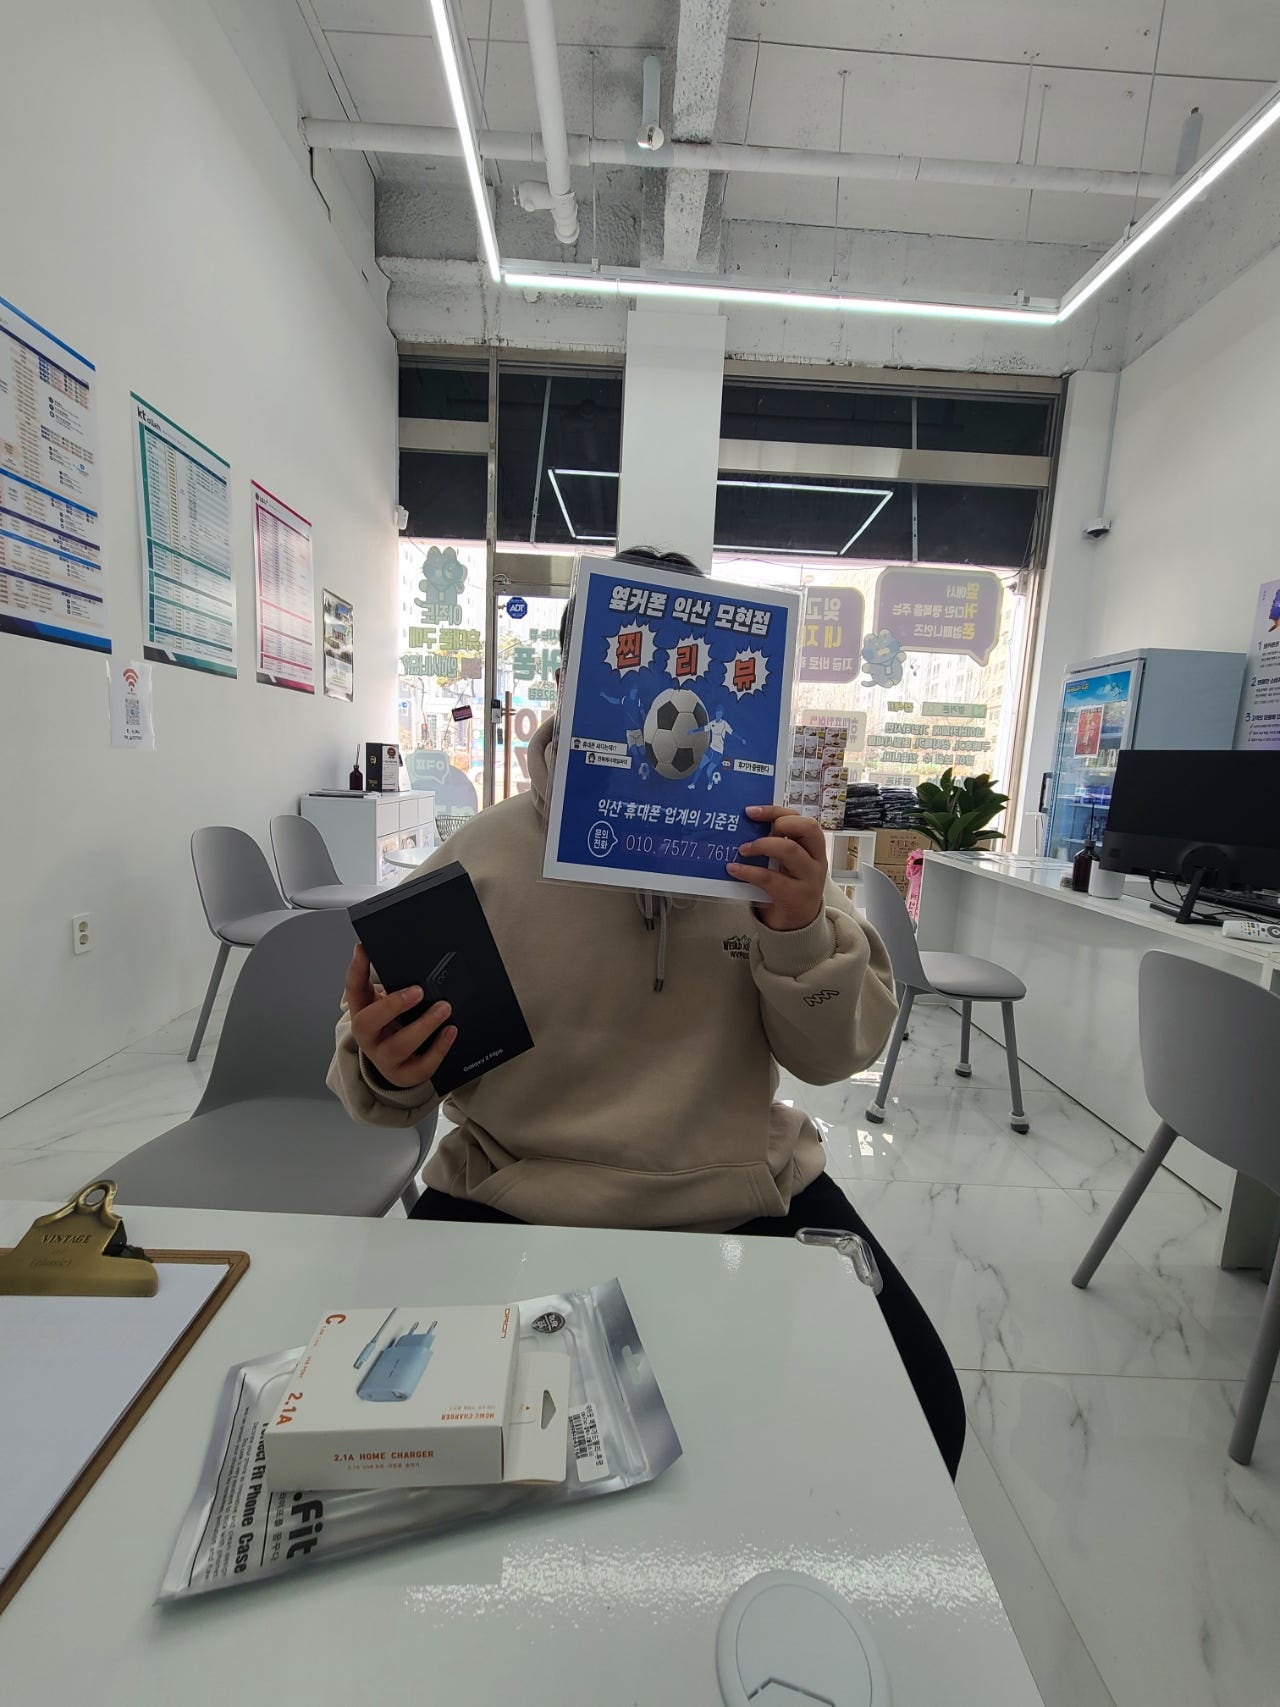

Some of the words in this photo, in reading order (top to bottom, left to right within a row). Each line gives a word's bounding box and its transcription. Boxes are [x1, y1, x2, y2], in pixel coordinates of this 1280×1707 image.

[137, 406, 147, 422] kt
[509, 603, 526, 614] ADT
[609, 585, 668, 618] 옆커폰
[672, 597, 711, 625] 익산
[714, 604, 772, 636] 모현점
[617, 631, 643, 669] 찐
[676, 643, 699, 677] 리
[733, 657, 757, 692] 뷰
[598, 798, 622, 818] 익산
[624, 802, 662, 823] 휴대폰
[664, 807, 701, 827] 업계의
[703, 812, 740, 832] 기준점
[594, 828, 609, 840] 문의
[593, 838, 608, 850] 전화
[42, 1234, 92, 1244] VINTAGE
[276, 1392, 303, 1426] 2.1A
[334, 1453, 354, 1462] 2.1A
[359, 1452, 385, 1461] HOME
[391, 1450, 434, 1460] CHARGER
[251, 1464, 266, 1481] Fit
[241, 1483, 262, 1527] Phone
[234, 1532, 254, 1574] Case
